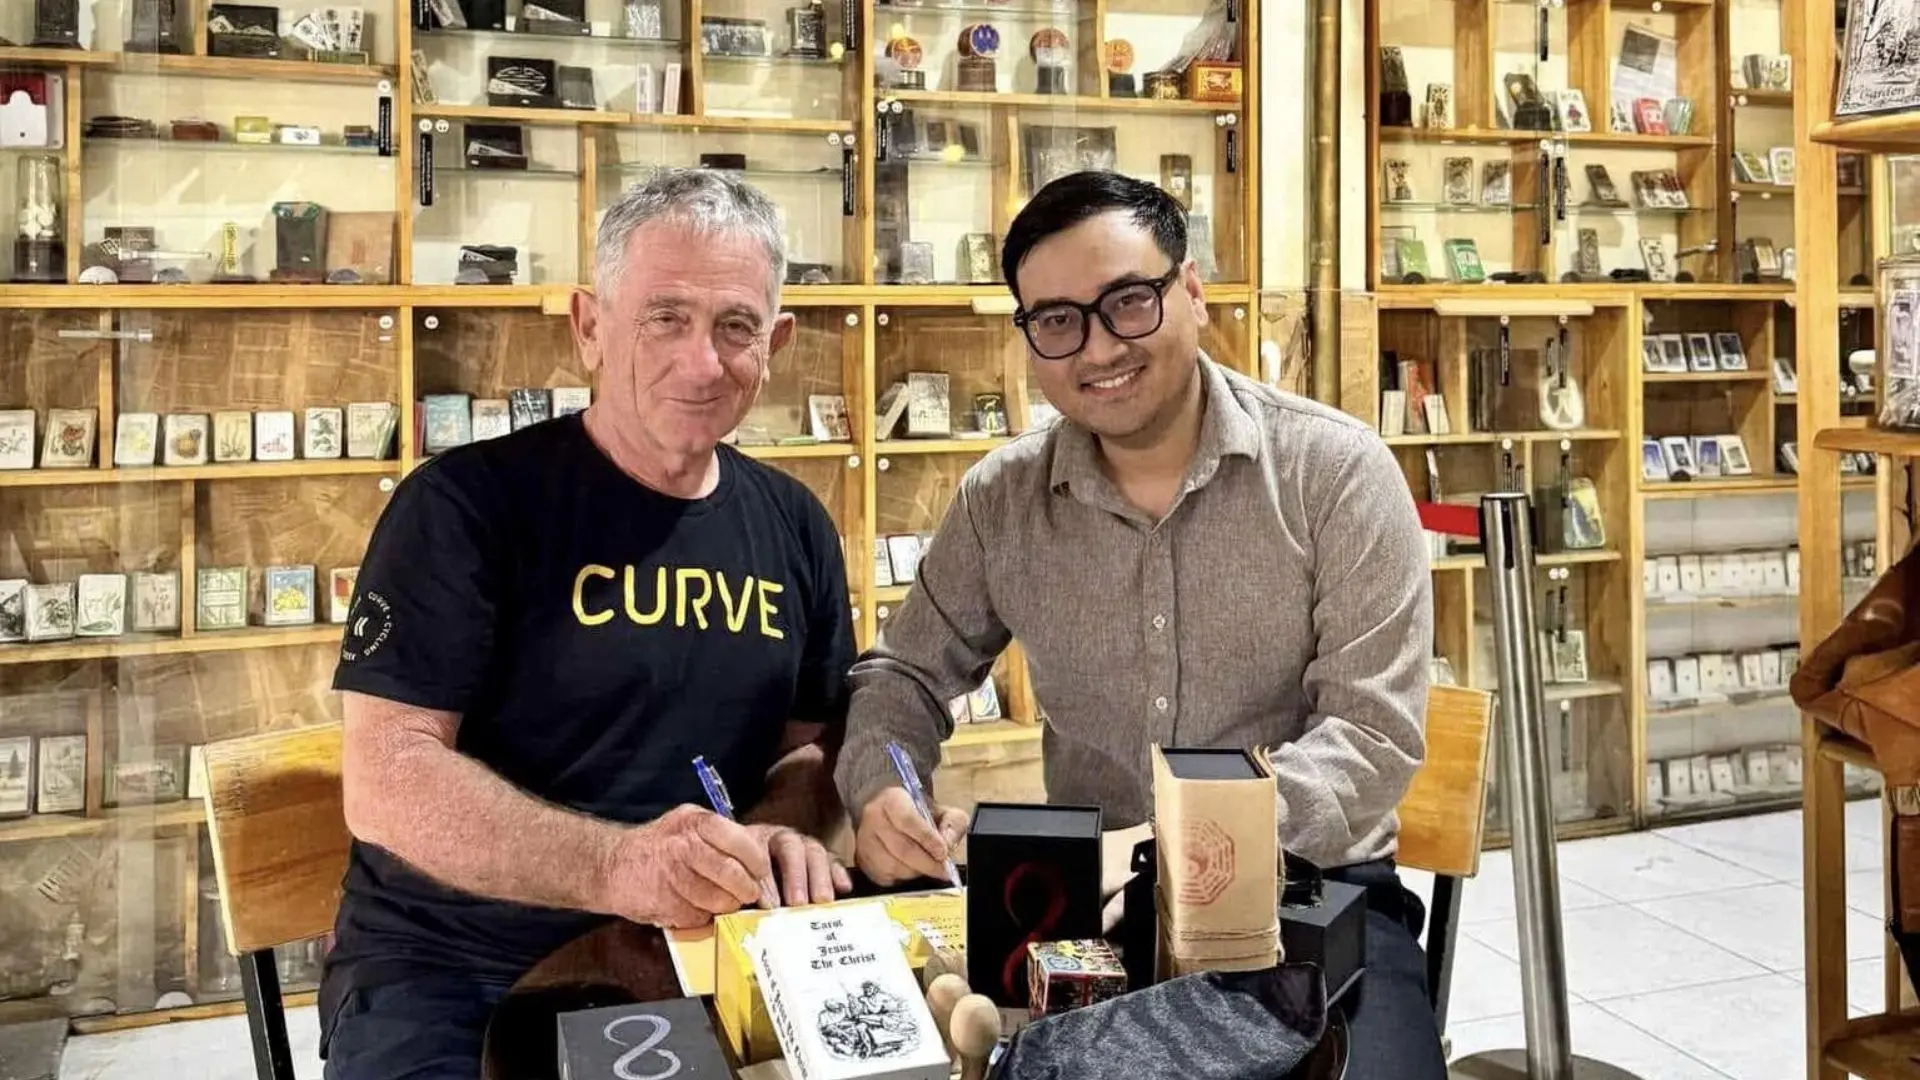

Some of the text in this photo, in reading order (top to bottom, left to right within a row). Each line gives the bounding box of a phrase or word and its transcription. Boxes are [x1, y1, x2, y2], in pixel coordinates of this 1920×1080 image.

[572, 563, 784, 639] CURVE
[363, 622, 392, 657] CYCLING
[810, 919, 844, 930] Tarot
[825, 931, 838, 941] of
[817, 943, 855, 957] Jesus
[810, 952, 877, 970] The Christ
